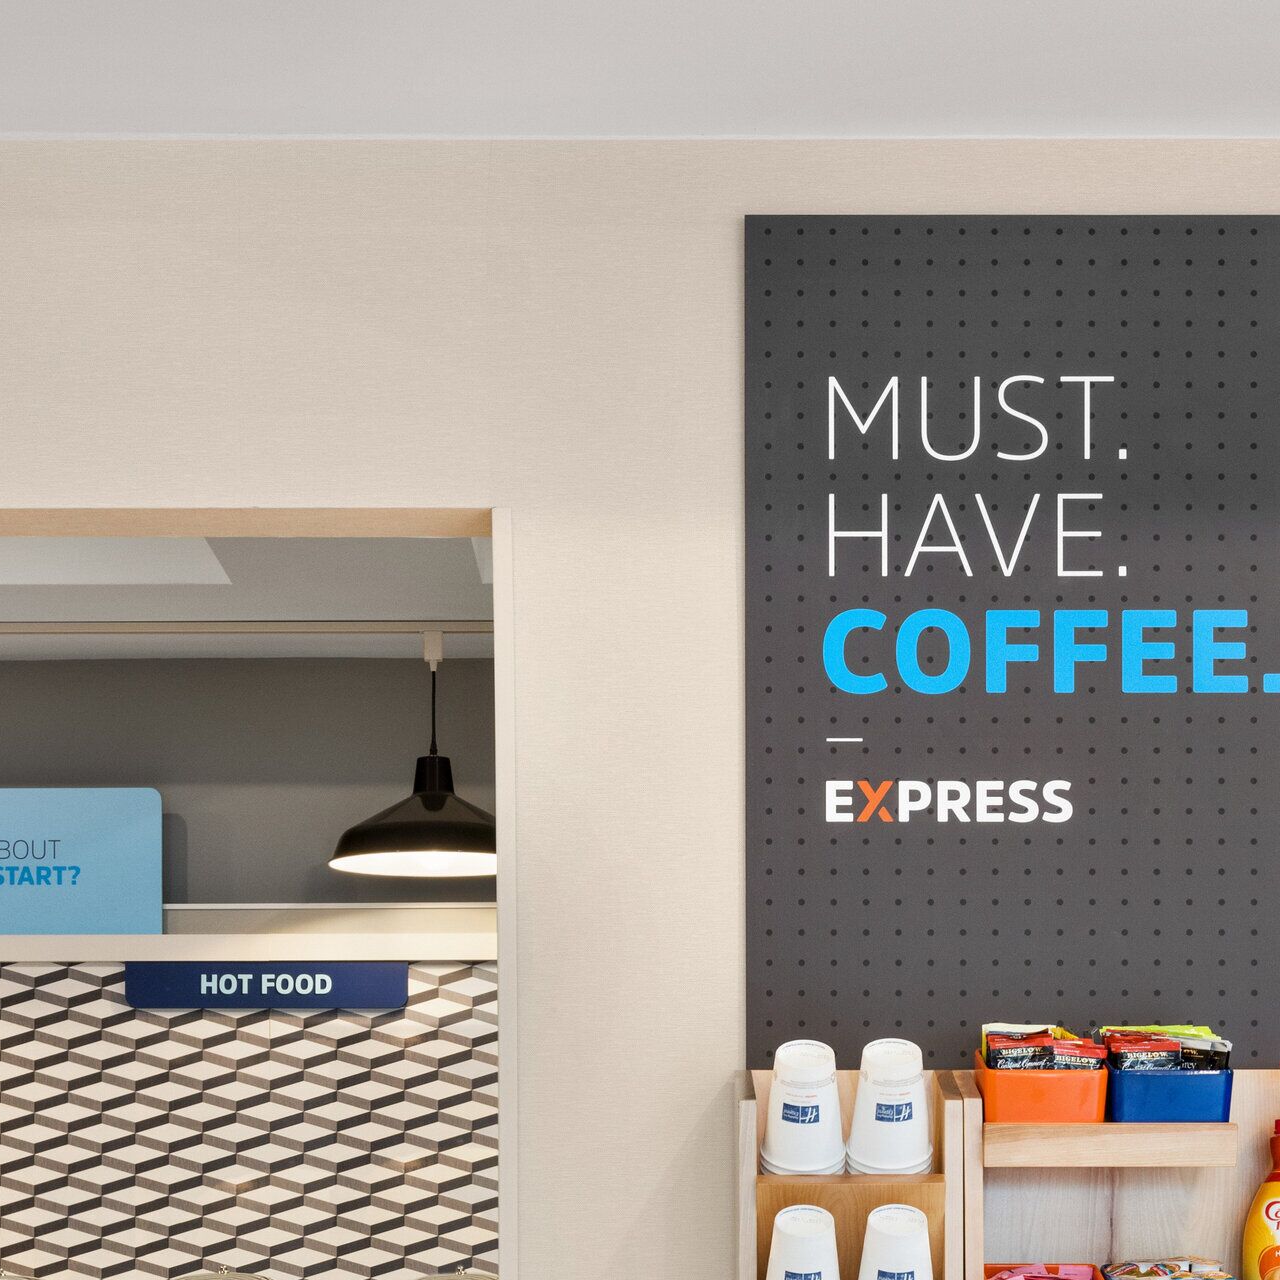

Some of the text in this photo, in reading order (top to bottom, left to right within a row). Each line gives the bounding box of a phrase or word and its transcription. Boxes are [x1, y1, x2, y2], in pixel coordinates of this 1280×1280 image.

[827, 374, 1128, 461] MUST.
[827, 492, 1128, 578] HAVE.
[825, 779, 1074, 823] EXPRESS
[199, 973, 333, 996] HOT FOOD
